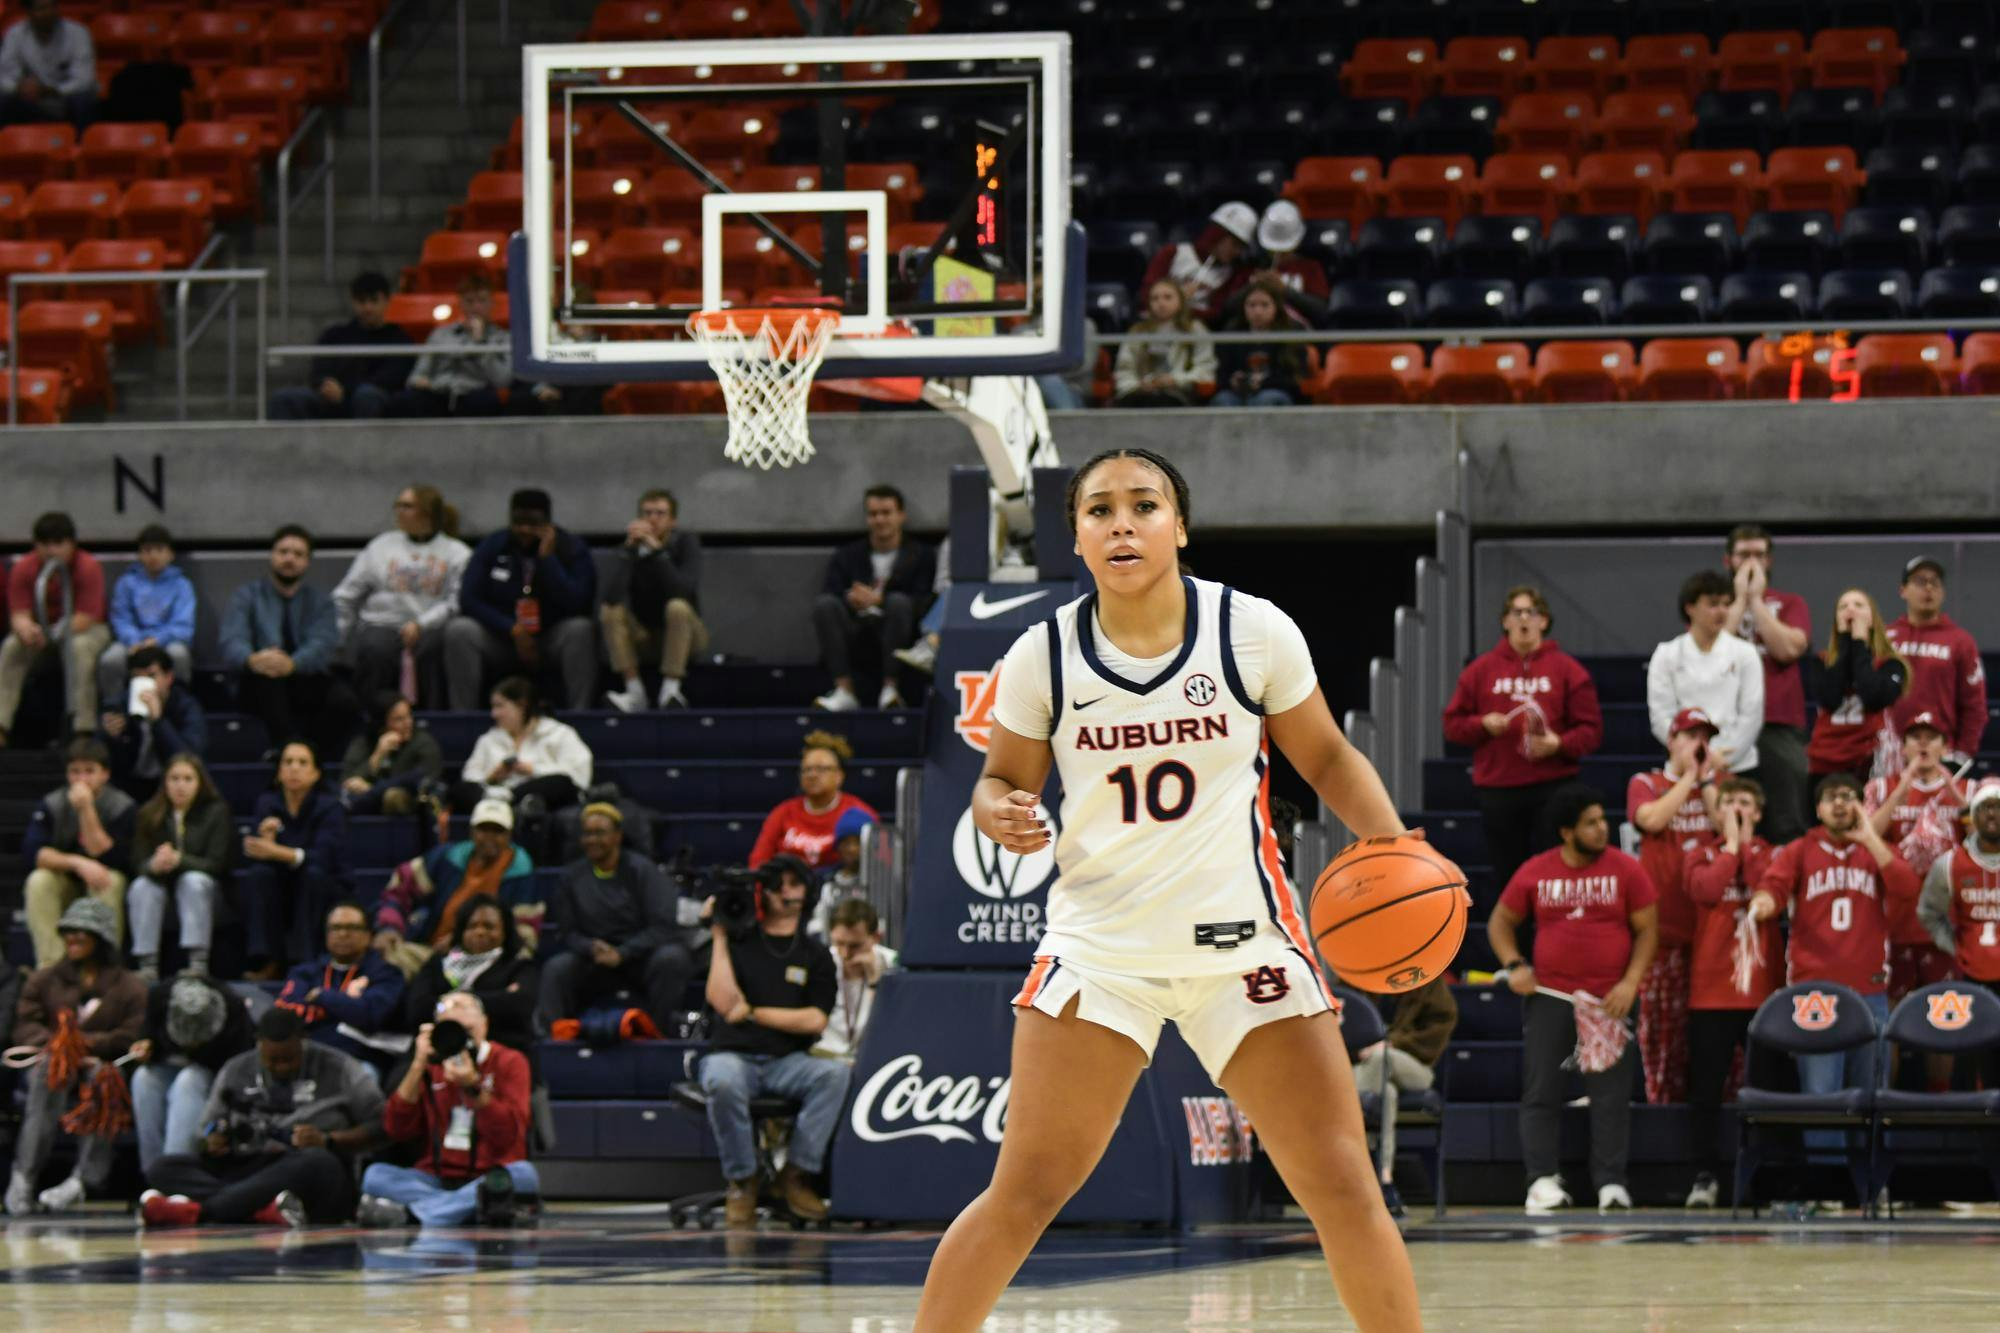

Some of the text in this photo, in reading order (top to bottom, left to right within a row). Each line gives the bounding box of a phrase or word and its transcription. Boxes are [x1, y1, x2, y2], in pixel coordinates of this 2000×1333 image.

[114, 454, 164, 513] N
[1185, 675, 1216, 706] SEC
[1492, 676, 1551, 695] JESUS
[1075, 713, 1230, 751] AUBURN
[1107, 758, 1196, 824] 10
[1806, 865, 1874, 901] ALABAMA
[967, 902, 1040, 923] WIND
[1831, 897, 1851, 931] 0
[958, 921, 1043, 943] CREEK
[851, 1054, 1012, 1143] Coca-C
